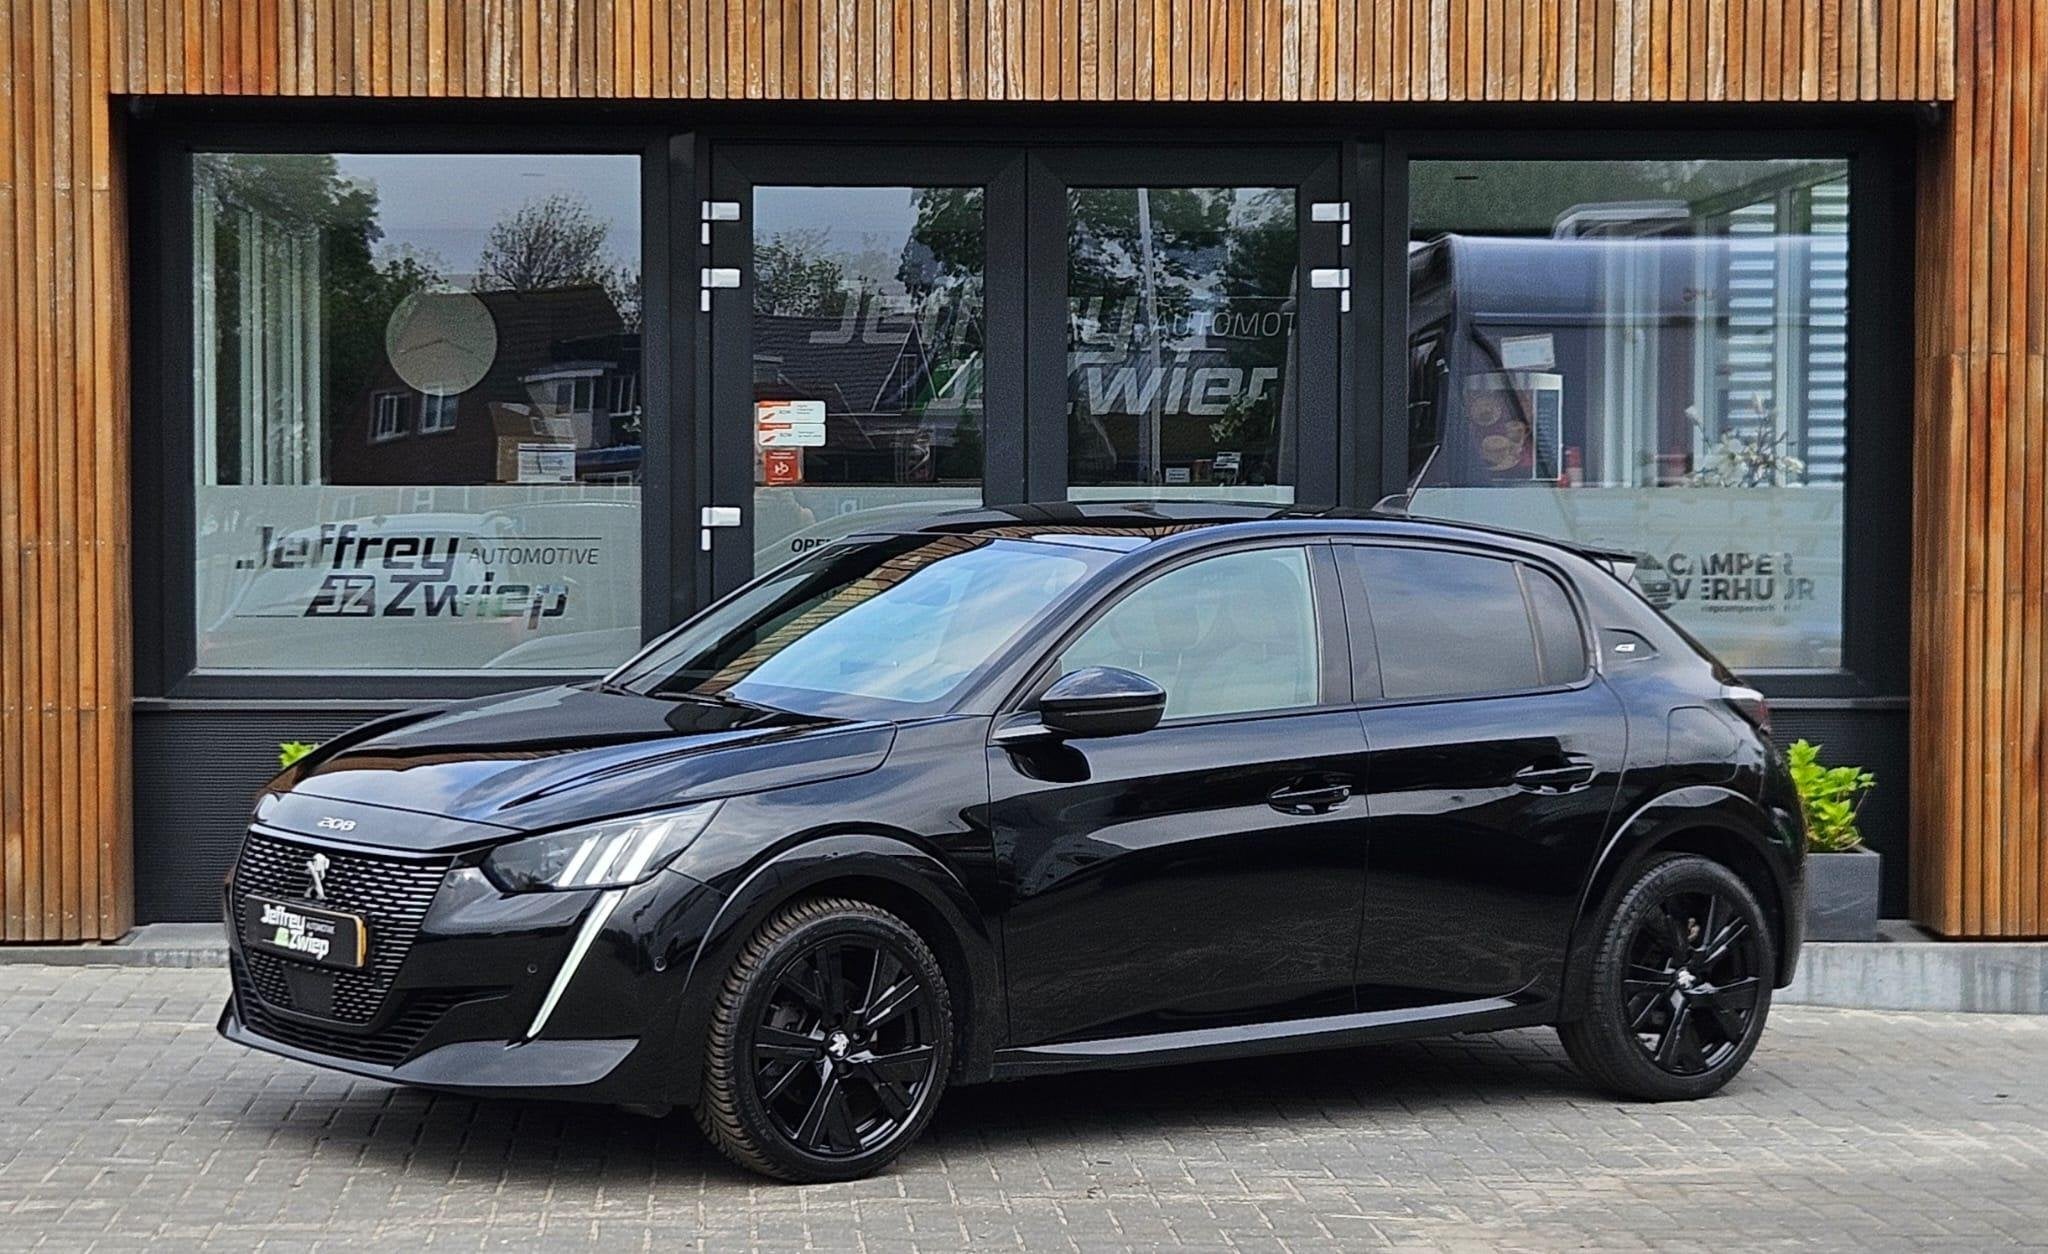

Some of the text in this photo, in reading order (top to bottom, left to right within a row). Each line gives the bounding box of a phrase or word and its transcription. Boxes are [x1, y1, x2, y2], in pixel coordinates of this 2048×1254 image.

[236, 524, 600, 583] Jeffrey AUTOMOTIVE
[383, 571, 569, 630] Zwiep
[317, 816, 356, 831] 208
[260, 903, 307, 936] Jeffrey
[288, 930, 330, 961] Zwiep
